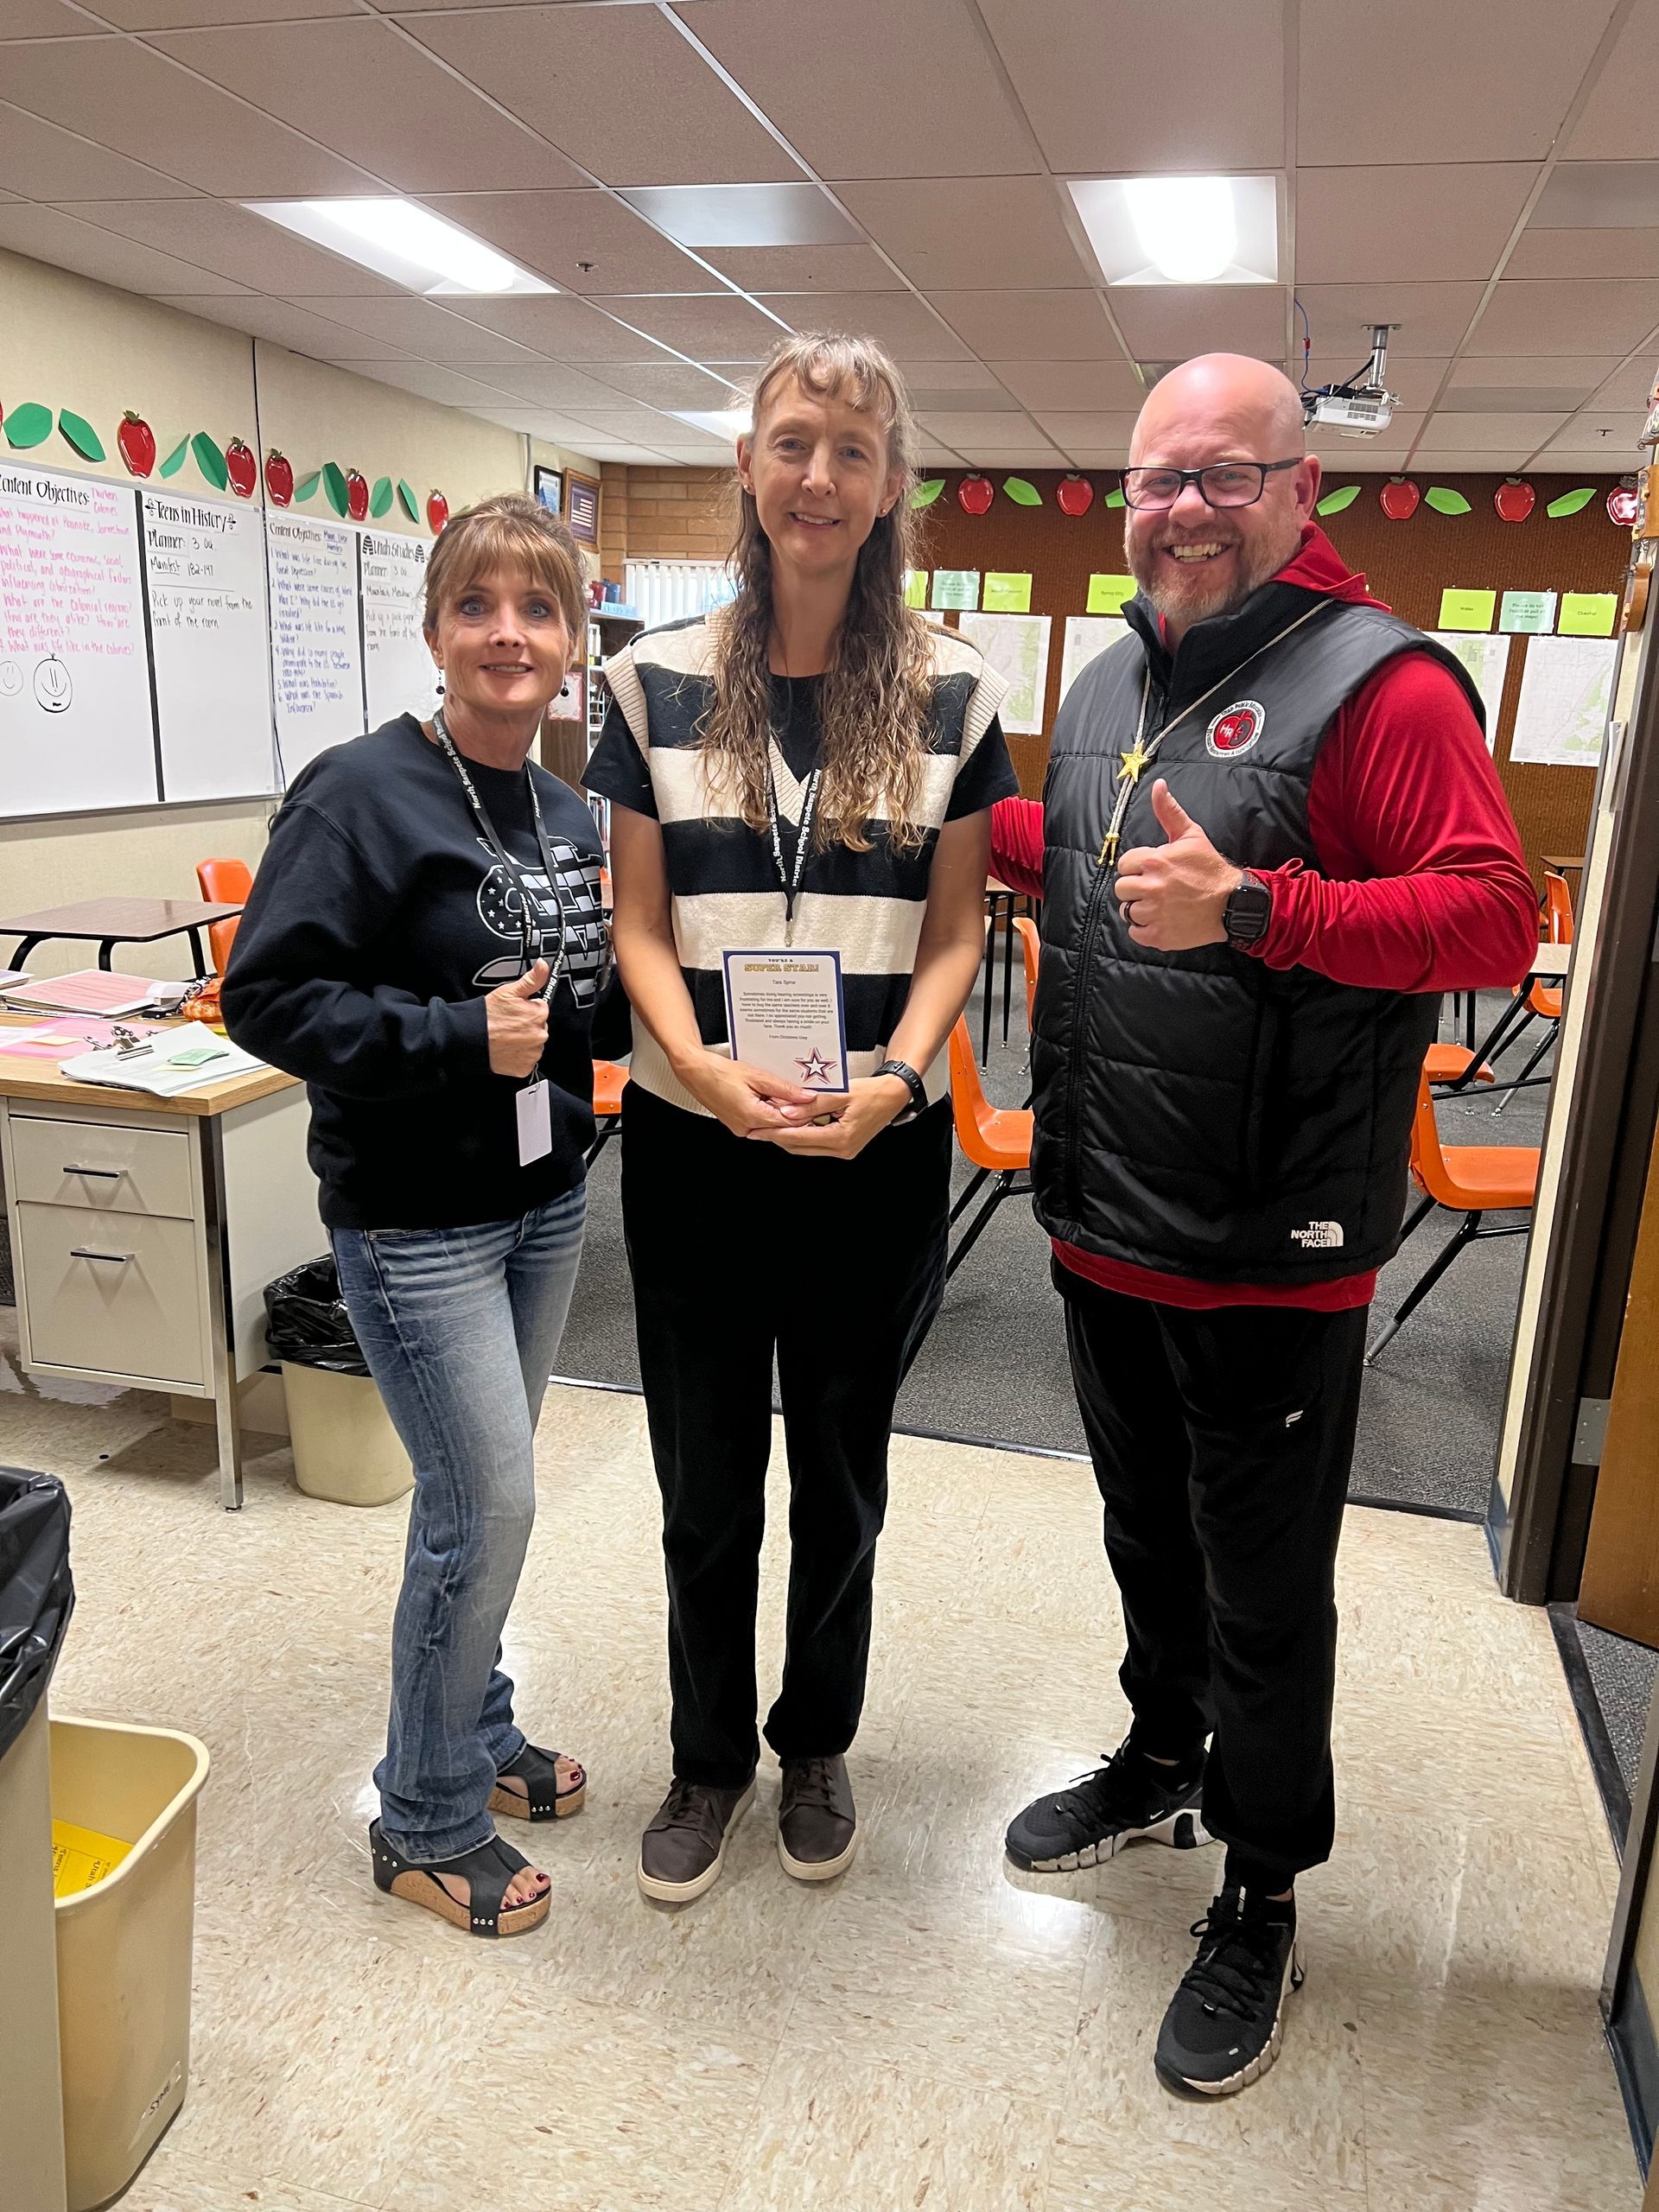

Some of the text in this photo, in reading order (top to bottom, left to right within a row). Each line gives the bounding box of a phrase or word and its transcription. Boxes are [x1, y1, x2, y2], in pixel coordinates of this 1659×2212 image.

[36, 480, 90, 505] Objectives:
[155, 499, 226, 532] Teens in History
[270, 523, 290, 537] Content
[192, 537, 200, 550] 3
[373, 539, 415, 560] Utah Studies
[41, 563, 54, 575] and
[393, 565, 398, 575] 3
[3, 593, 27, 607] What
[34, 598, 45, 608] are
[51, 596, 63, 608] the
[152, 590, 252, 613] Pick up your novel from the
[4, 610, 21, 622] How
[25, 613, 36, 623] are
[66, 613, 89, 625] alike?
[118, 619, 130, 628] are
[152, 611, 219, 630] front of the room
[8, 625, 69, 642] they different?
[9, 640, 29, 652] What
[52, 640, 63, 653] life
[66, 641, 79, 652] like
[82, 642, 90, 651] in
[92, 641, 103, 653] the
[1220, 724, 1234, 738] HR
[439, 733, 481, 809] North Sanpete School
[791, 768, 822, 887] North Sanpete School District
[772, 823, 781, 857] Sanpete
[776, 855, 786, 882] North
[519, 893, 531, 924] District
[551, 950, 563, 977] School
[744, 963, 819, 972] SUPER STAR!
[1308, 1221, 1329, 1230] THE
[1291, 1230, 1327, 1239] NORTH
[1301, 1238, 1327, 1248] FACE
